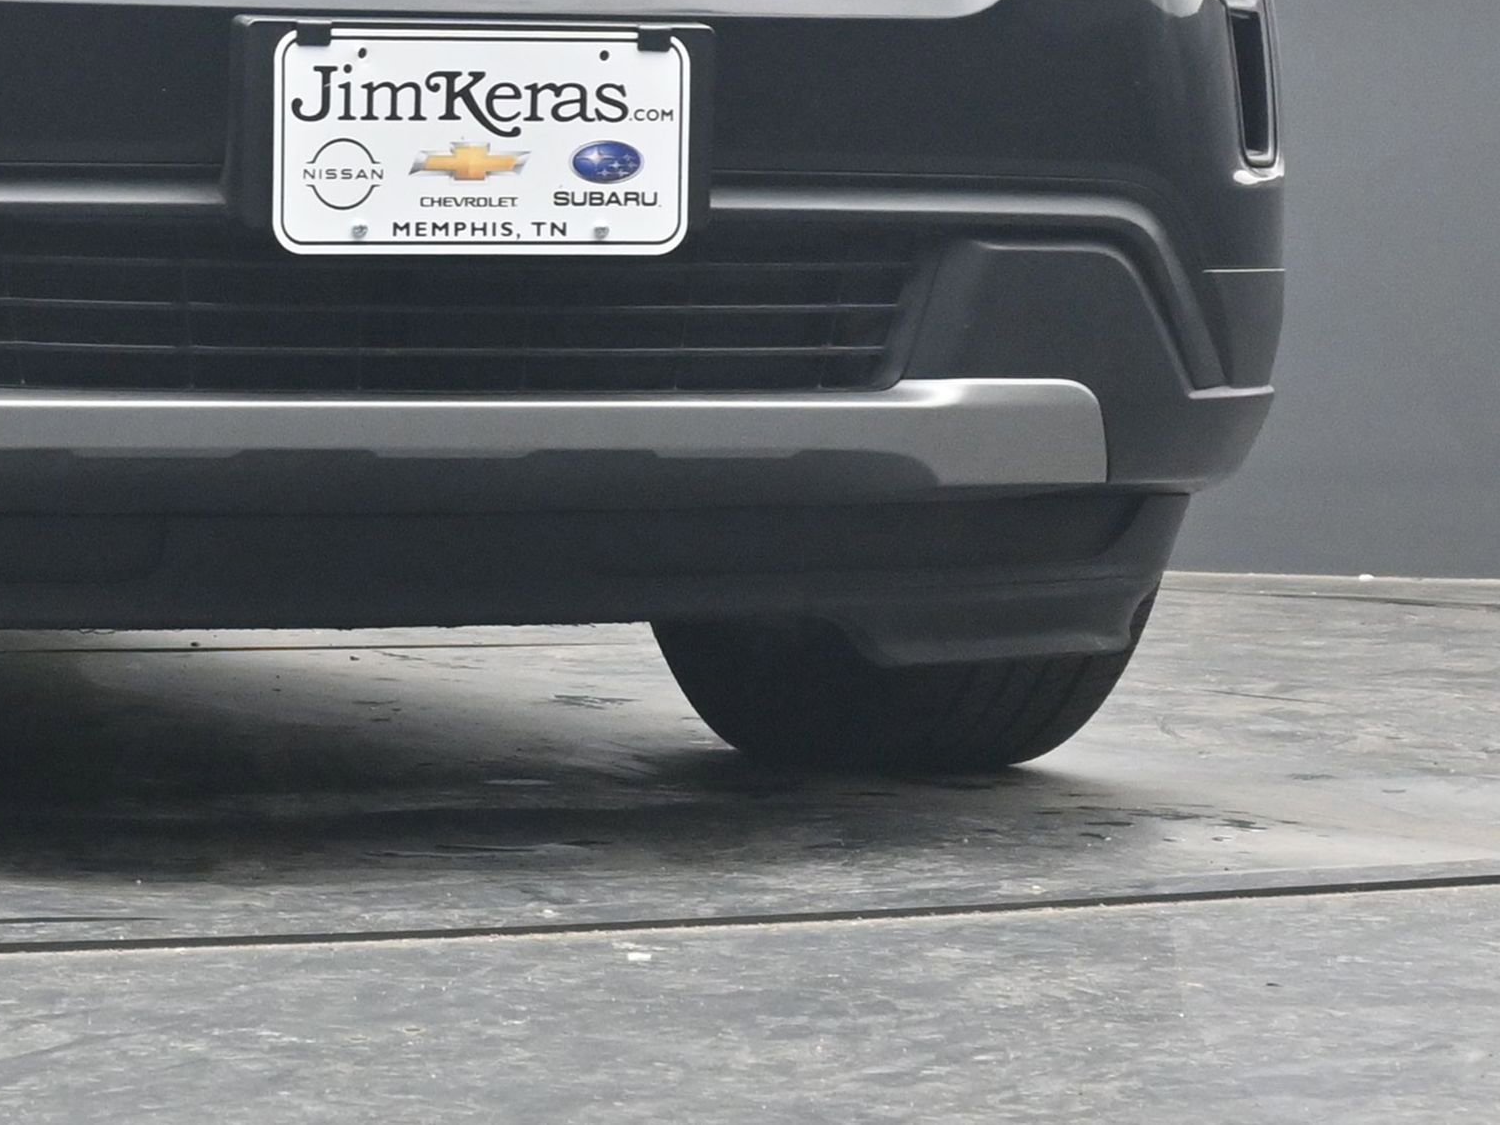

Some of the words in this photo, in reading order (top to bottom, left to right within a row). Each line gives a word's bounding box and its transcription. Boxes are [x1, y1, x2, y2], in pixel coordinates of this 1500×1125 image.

[303, 167, 384, 180] NISSAN
[419, 195, 518, 208] CHEVROLET
[553, 191, 660, 207] SUBARU
[392, 222, 521, 239] MEMPHIS,
[532, 222, 568, 238] TN
